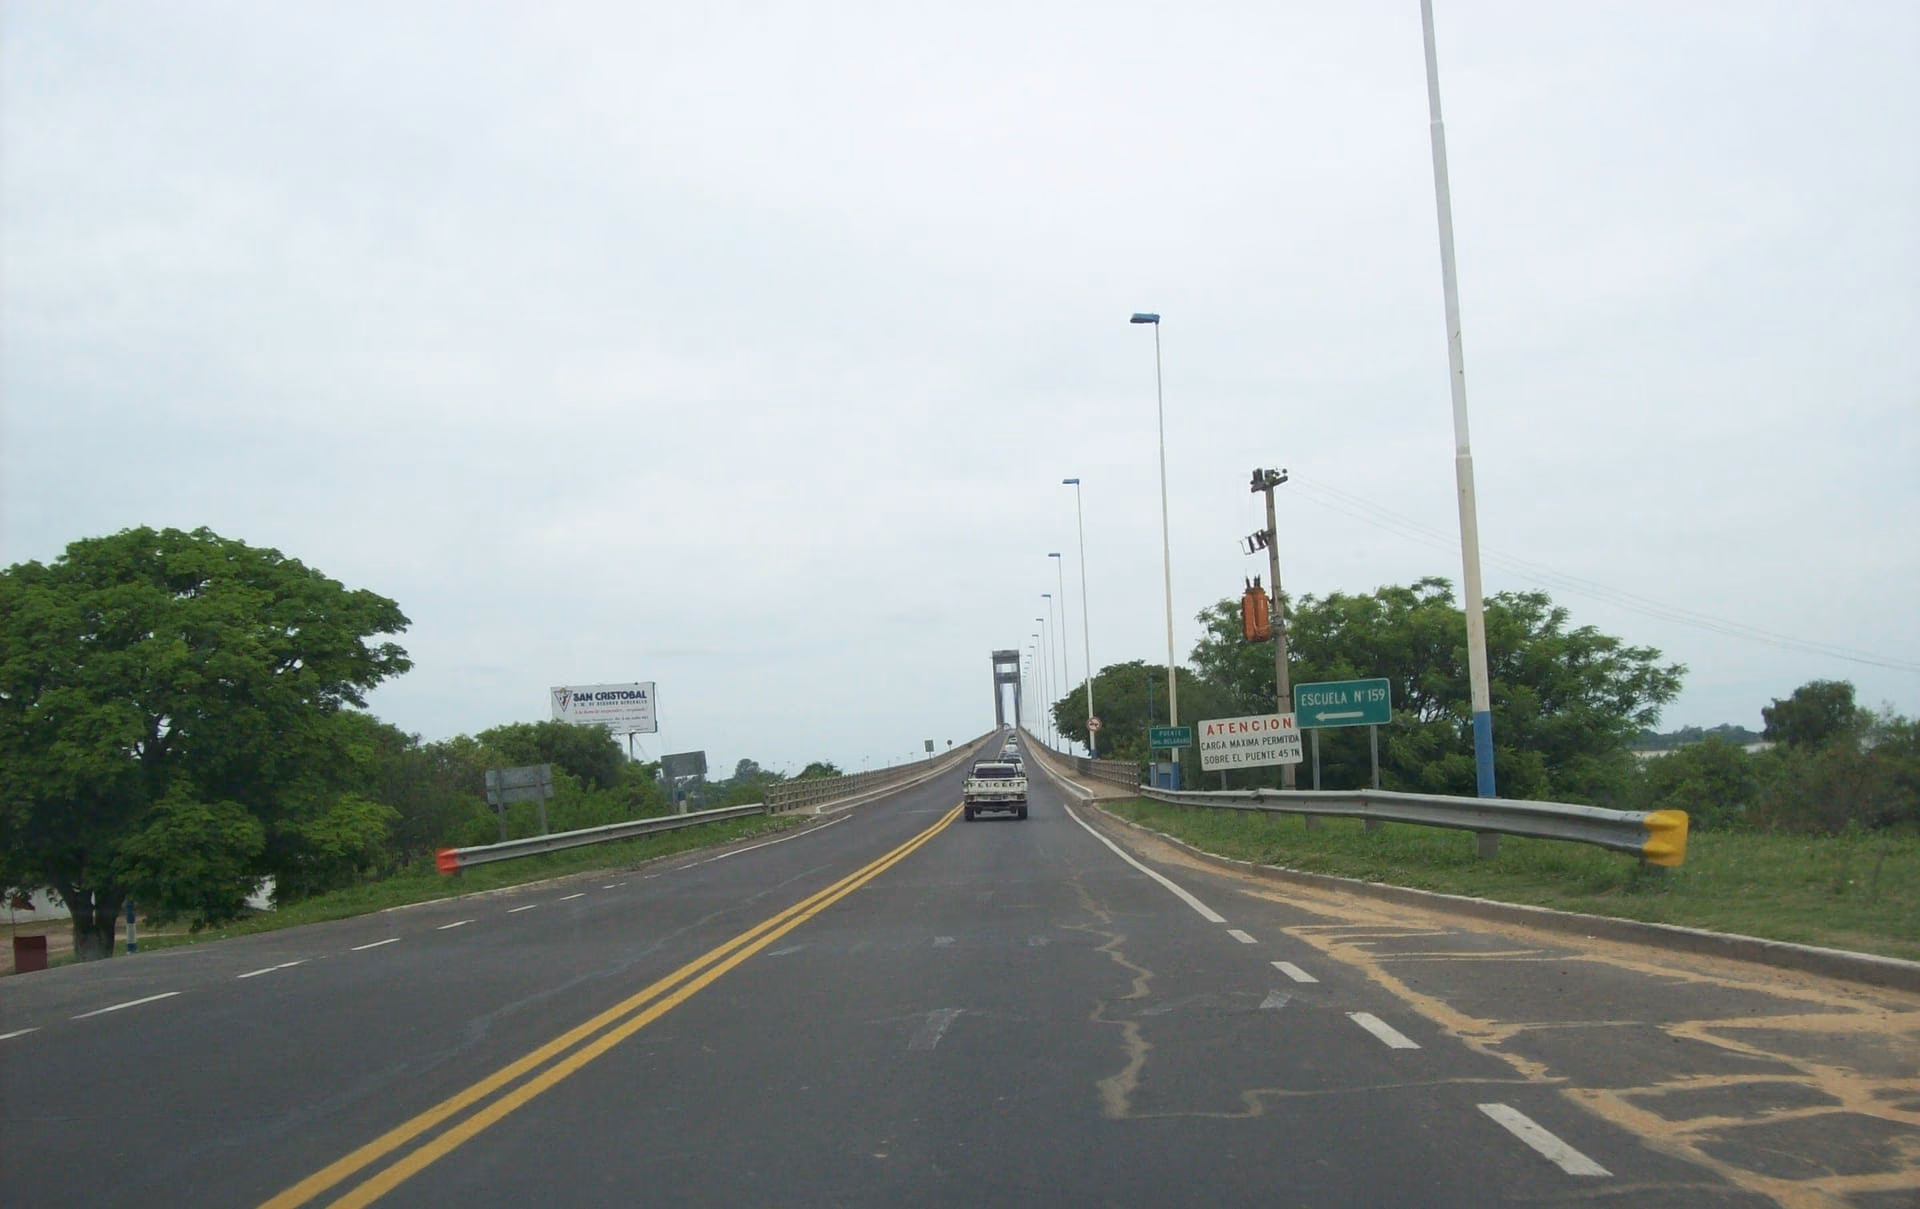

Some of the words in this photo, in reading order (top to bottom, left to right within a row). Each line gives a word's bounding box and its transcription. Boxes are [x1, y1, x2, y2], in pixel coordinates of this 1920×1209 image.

[573, 692, 593, 702] SAN
[595, 690, 647, 700] CRISTOBAL
[1301, 692, 1348, 706] ESCUELA
[1207, 717, 1292, 736] ATENCION
[1201, 741, 1227, 751] CARGA
[1230, 738, 1260, 749] MAXIMA
[1262, 734, 1300, 745] PERMITIDA
[1204, 754, 1230, 765] SOBRE
[1233, 753, 1243, 762] EL
[1246, 749, 1276, 761] PUENTE
[1278, 748, 1289, 758] 45
[1291, 747, 1300, 757] TN
